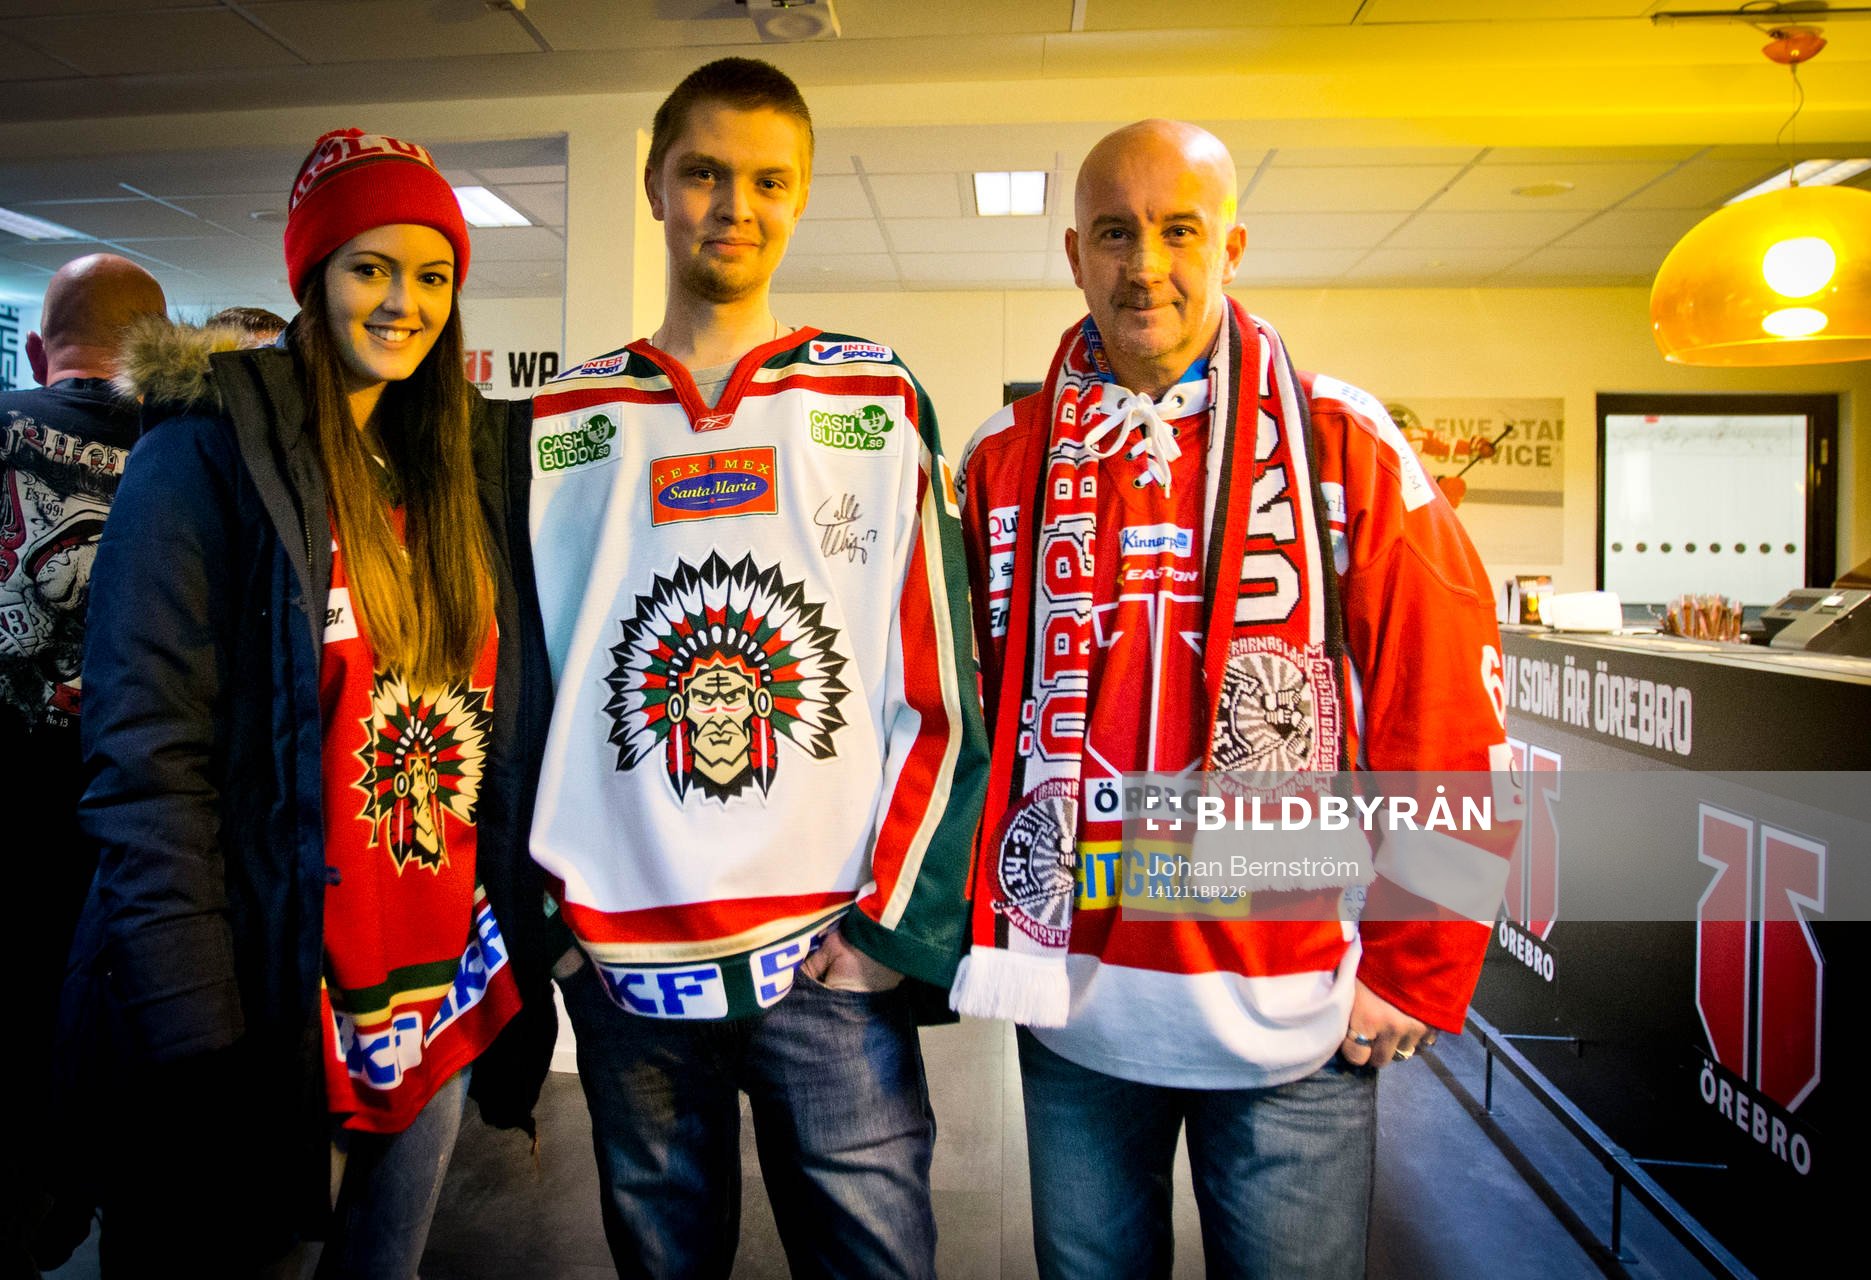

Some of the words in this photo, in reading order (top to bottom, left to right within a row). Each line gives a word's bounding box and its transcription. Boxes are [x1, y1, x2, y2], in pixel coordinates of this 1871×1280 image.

[843, 351, 887, 360] SPORT
[844, 344, 885, 353] INTER
[583, 355, 623, 369] INTER
[811, 411, 855, 432] CASH
[1433, 417, 1493, 441] FIVE
[541, 432, 585, 453] CASH
[655, 462, 700, 487] TEX
[724, 458, 770, 475] MEX
[667, 484, 711, 500] Santa
[711, 477, 757, 496] Maria
[1125, 566, 1199, 582] EASTON
[1519, 658, 1559, 721] SOM
[1562, 655, 1591, 729] ÄR
[1594, 660, 1693, 756] ÖREBRO
[1498, 912, 1555, 983] ÖREBRO
[1700, 1058, 1812, 1176] ÖREBRO
